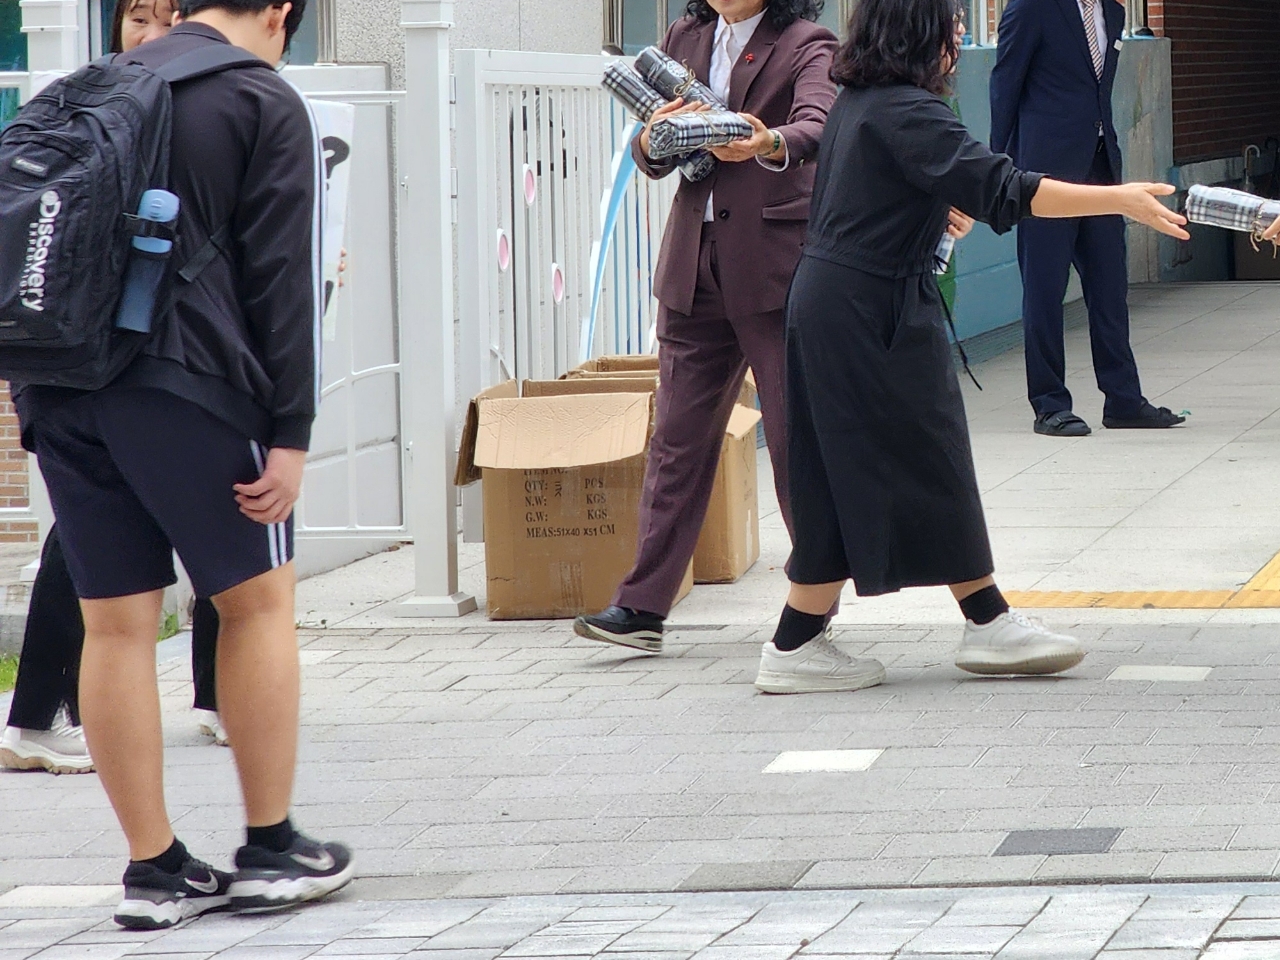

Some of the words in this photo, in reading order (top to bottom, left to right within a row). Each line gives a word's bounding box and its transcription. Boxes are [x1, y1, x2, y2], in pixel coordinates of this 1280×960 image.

[524, 480, 548, 493] QTY:
[584, 477, 604, 489] PCS
[525, 495, 547, 507] N.W:
[586, 493, 607, 505] KGS
[525, 511, 548, 522] G.W:
[587, 508, 608, 520] KGS
[600, 523, 615, 535] CM
